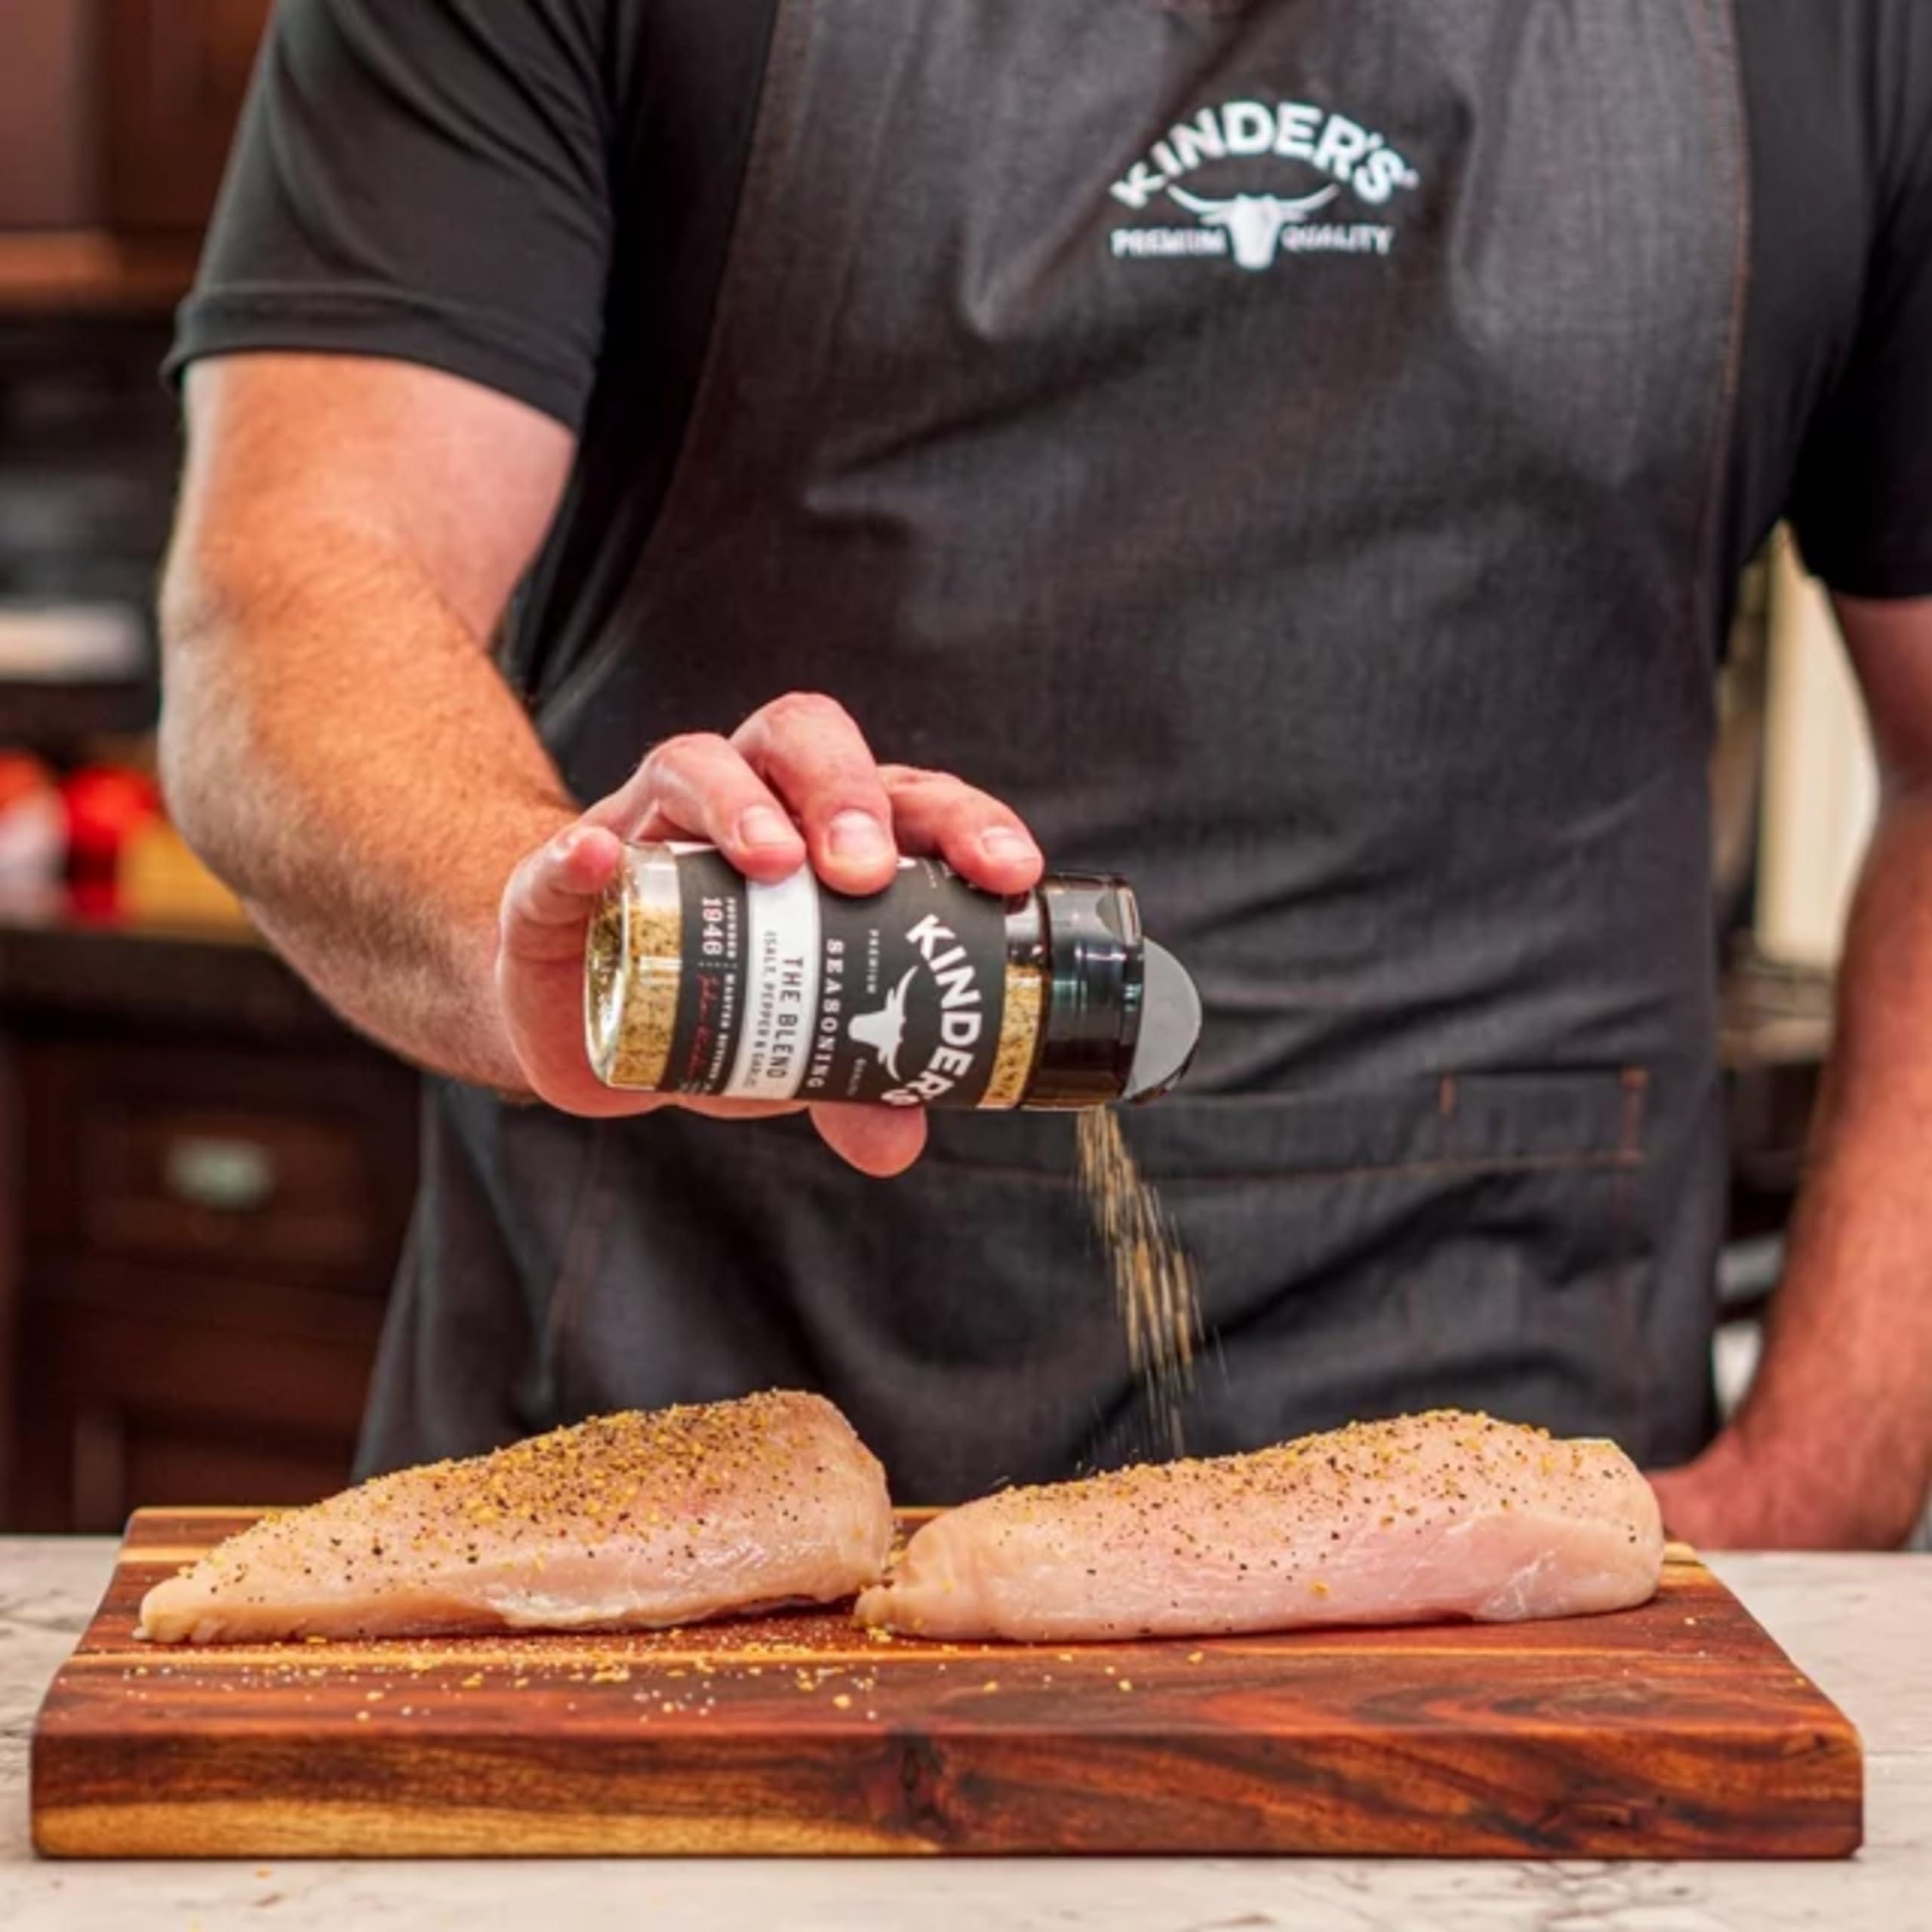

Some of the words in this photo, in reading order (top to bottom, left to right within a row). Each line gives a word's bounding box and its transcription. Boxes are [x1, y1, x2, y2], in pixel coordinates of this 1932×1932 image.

[1112, 229, 1226, 257] PREMIUM
[1282, 225, 1392, 255] QUALITY
[779, 957, 804, 1003] THE
[867, 929, 879, 993] PREMIUM
[757, 983, 774, 1037] PEPPER
[807, 938, 845, 1088] SEASONING
[766, 1013, 798, 1079] BLEND
